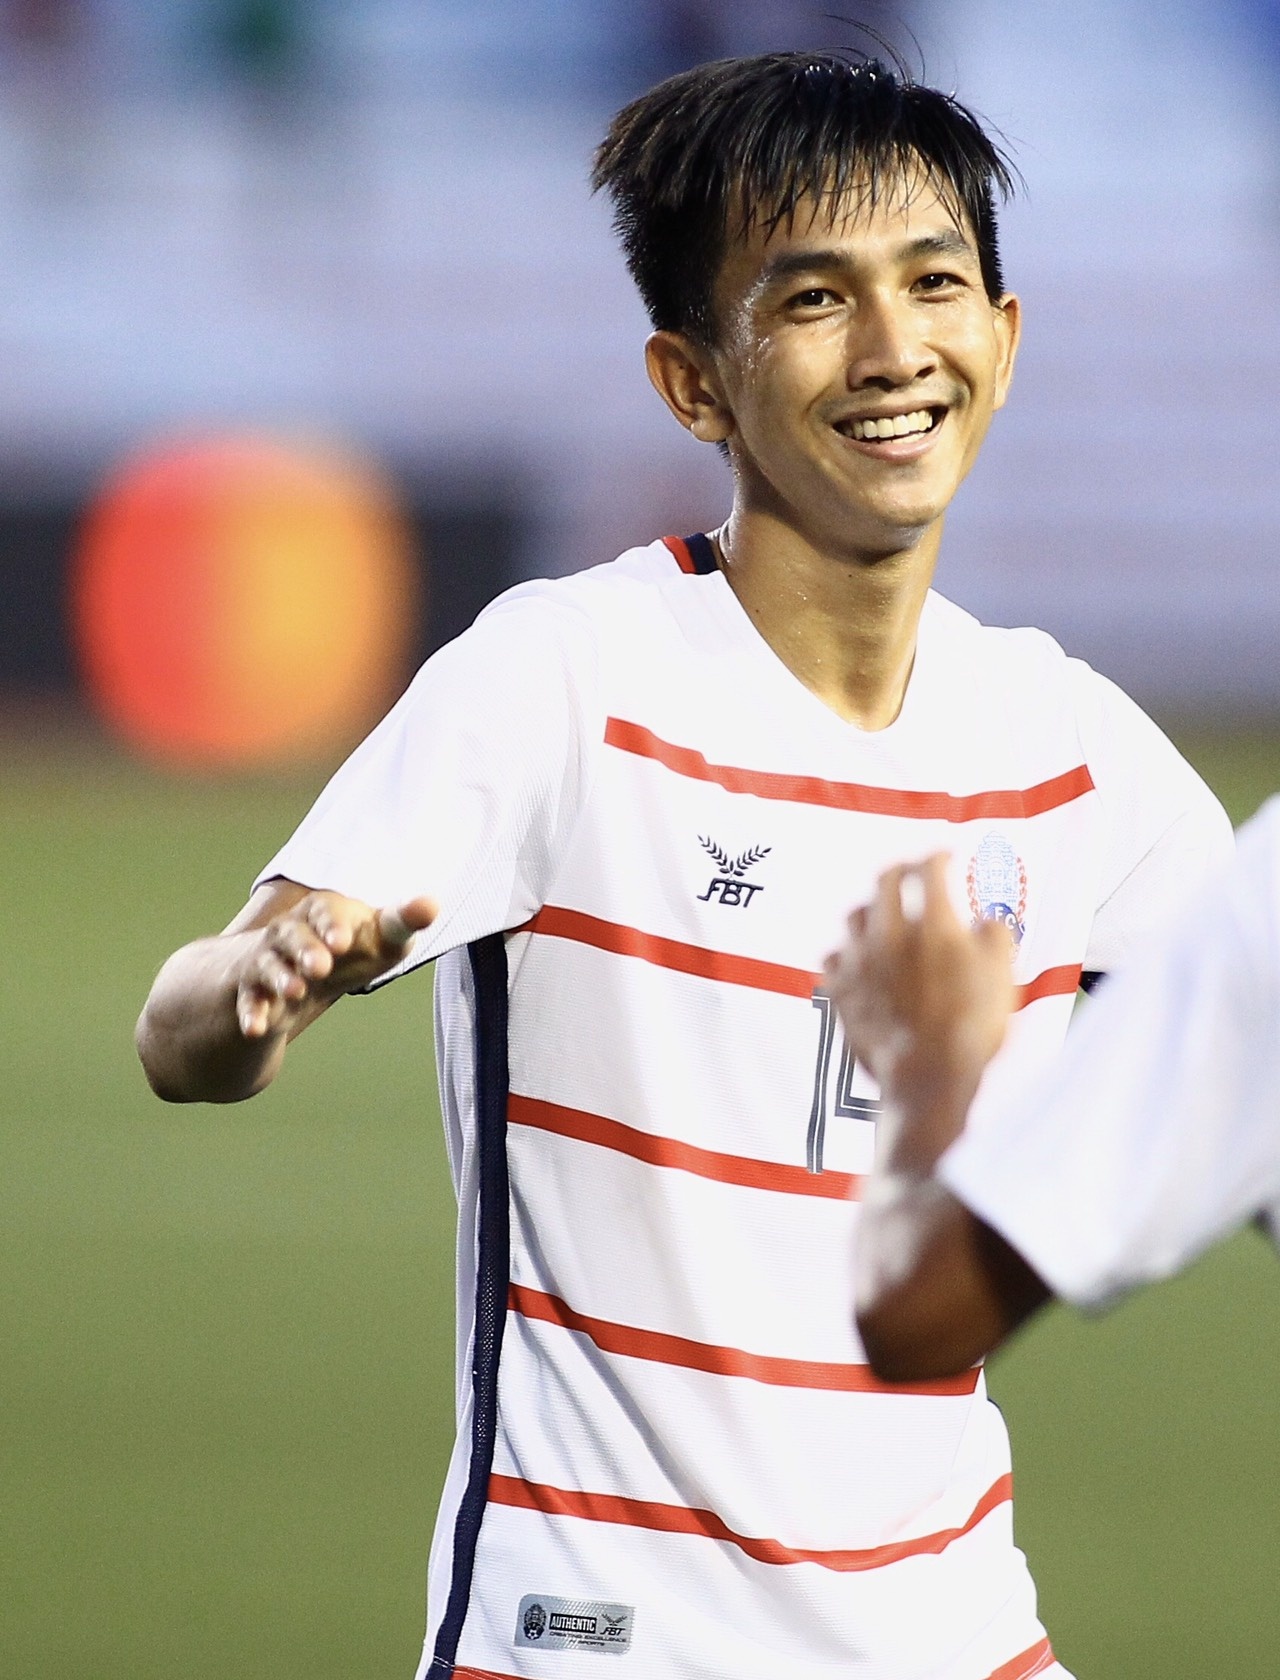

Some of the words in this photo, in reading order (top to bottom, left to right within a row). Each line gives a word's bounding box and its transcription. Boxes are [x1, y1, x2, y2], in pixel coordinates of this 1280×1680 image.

[696, 878, 765, 908] FBT
[550, 1614, 596, 1633] AUTHENTIC
[600, 1626, 626, 1636] FBT
